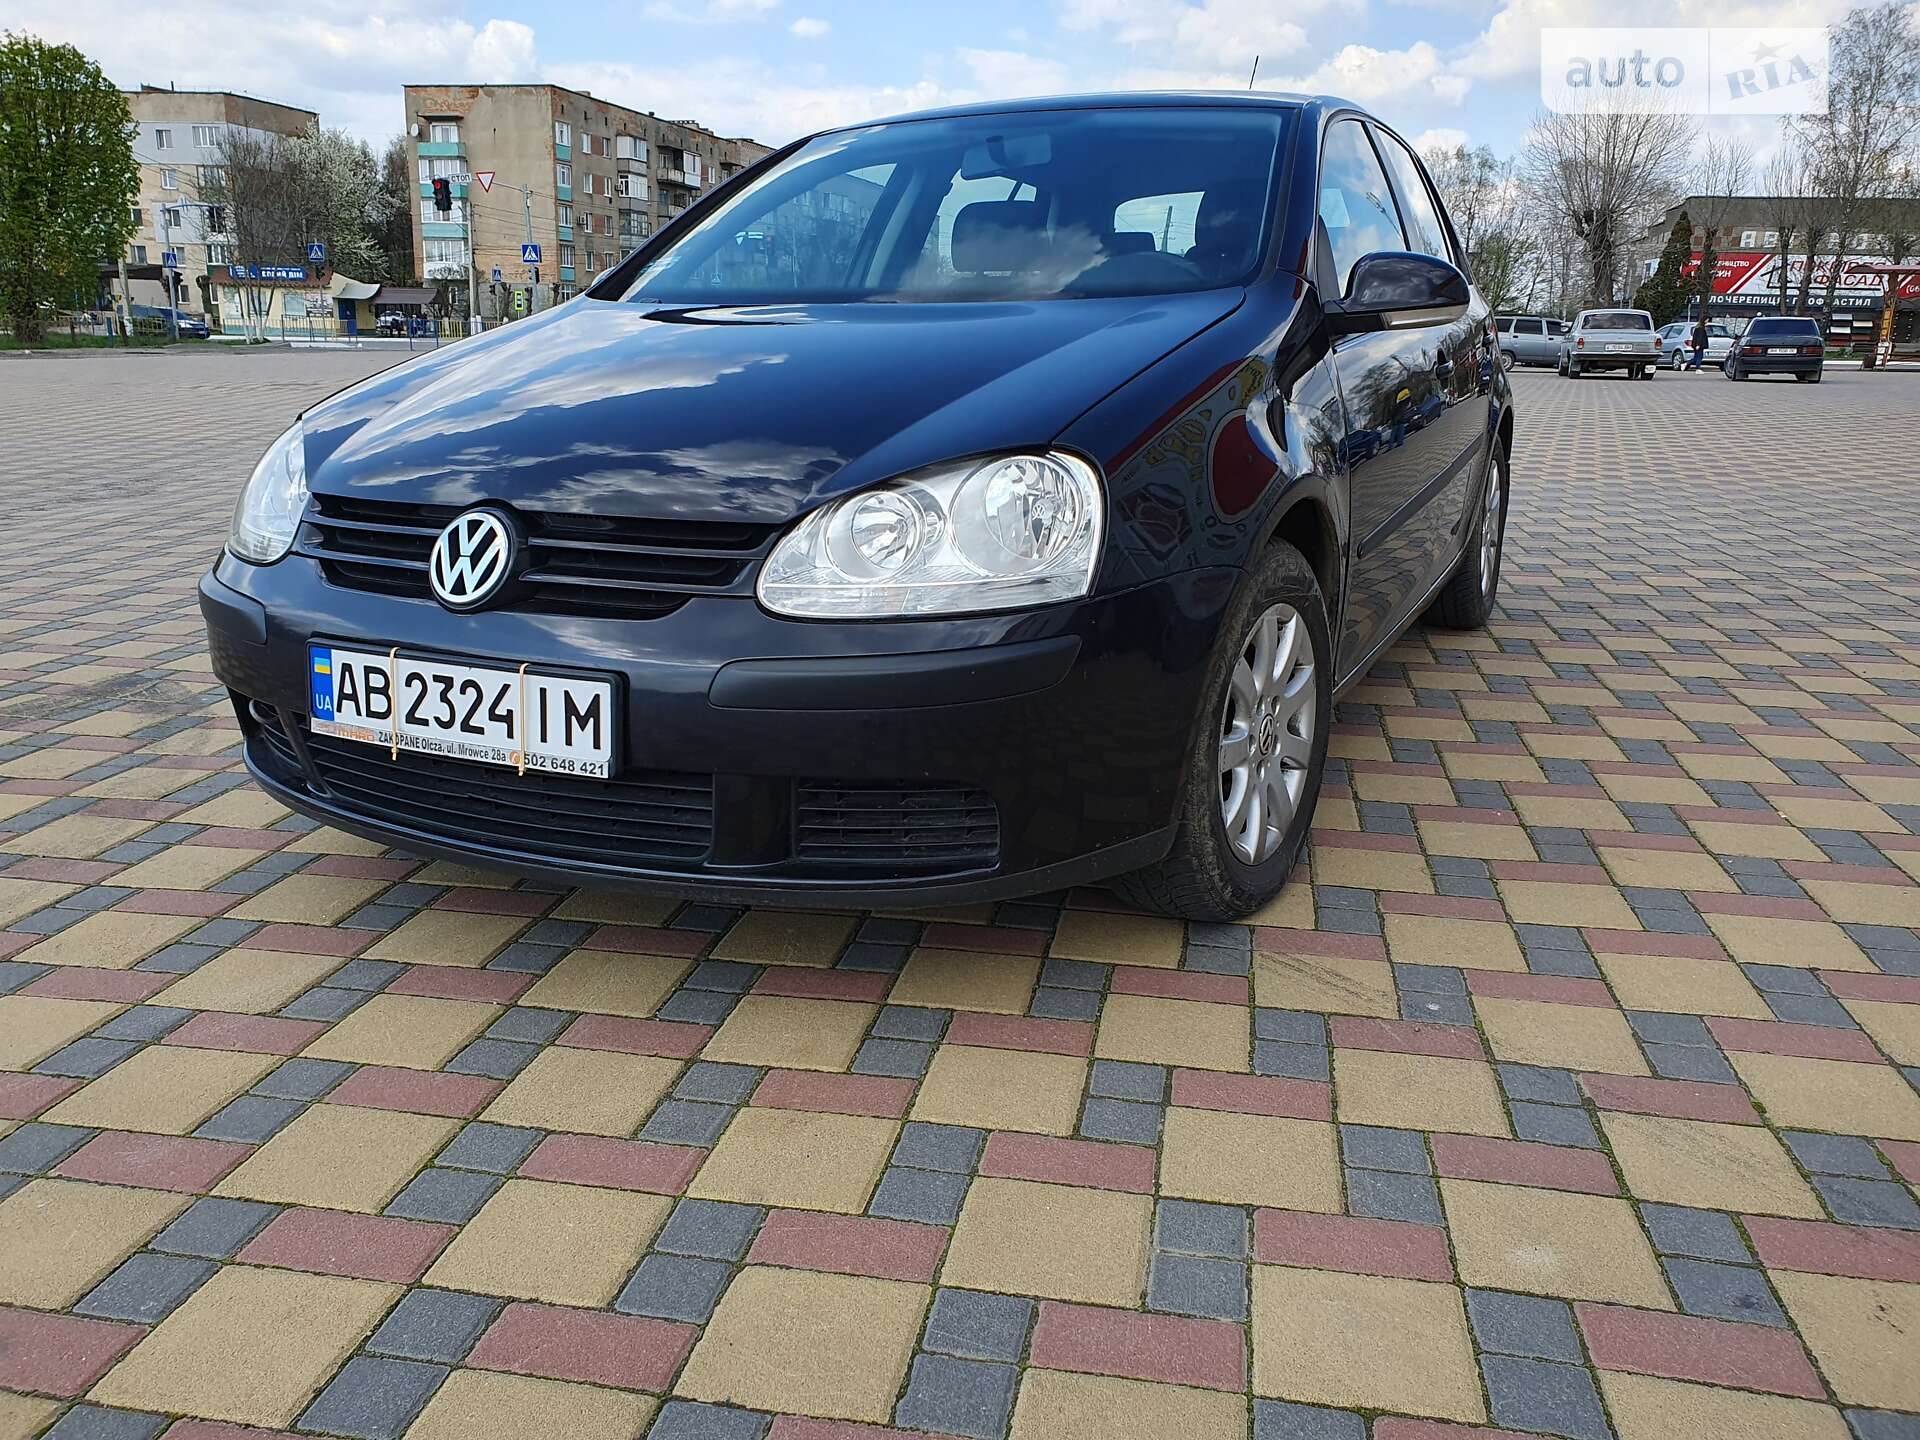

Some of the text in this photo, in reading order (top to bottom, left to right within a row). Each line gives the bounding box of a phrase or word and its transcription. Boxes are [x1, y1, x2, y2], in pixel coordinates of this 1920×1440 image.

[1813, 274, 1883, 286] ФАСАД
[315, 694, 333, 711] UA
[335, 662, 602, 750] AB 2324 IM
[458, 744, 489, 760] Mrowce
[491, 749, 507, 762] 28a
[524, 754, 546, 768] 502
[551, 758, 576, 772] 648
[580, 761, 605, 776] 421
